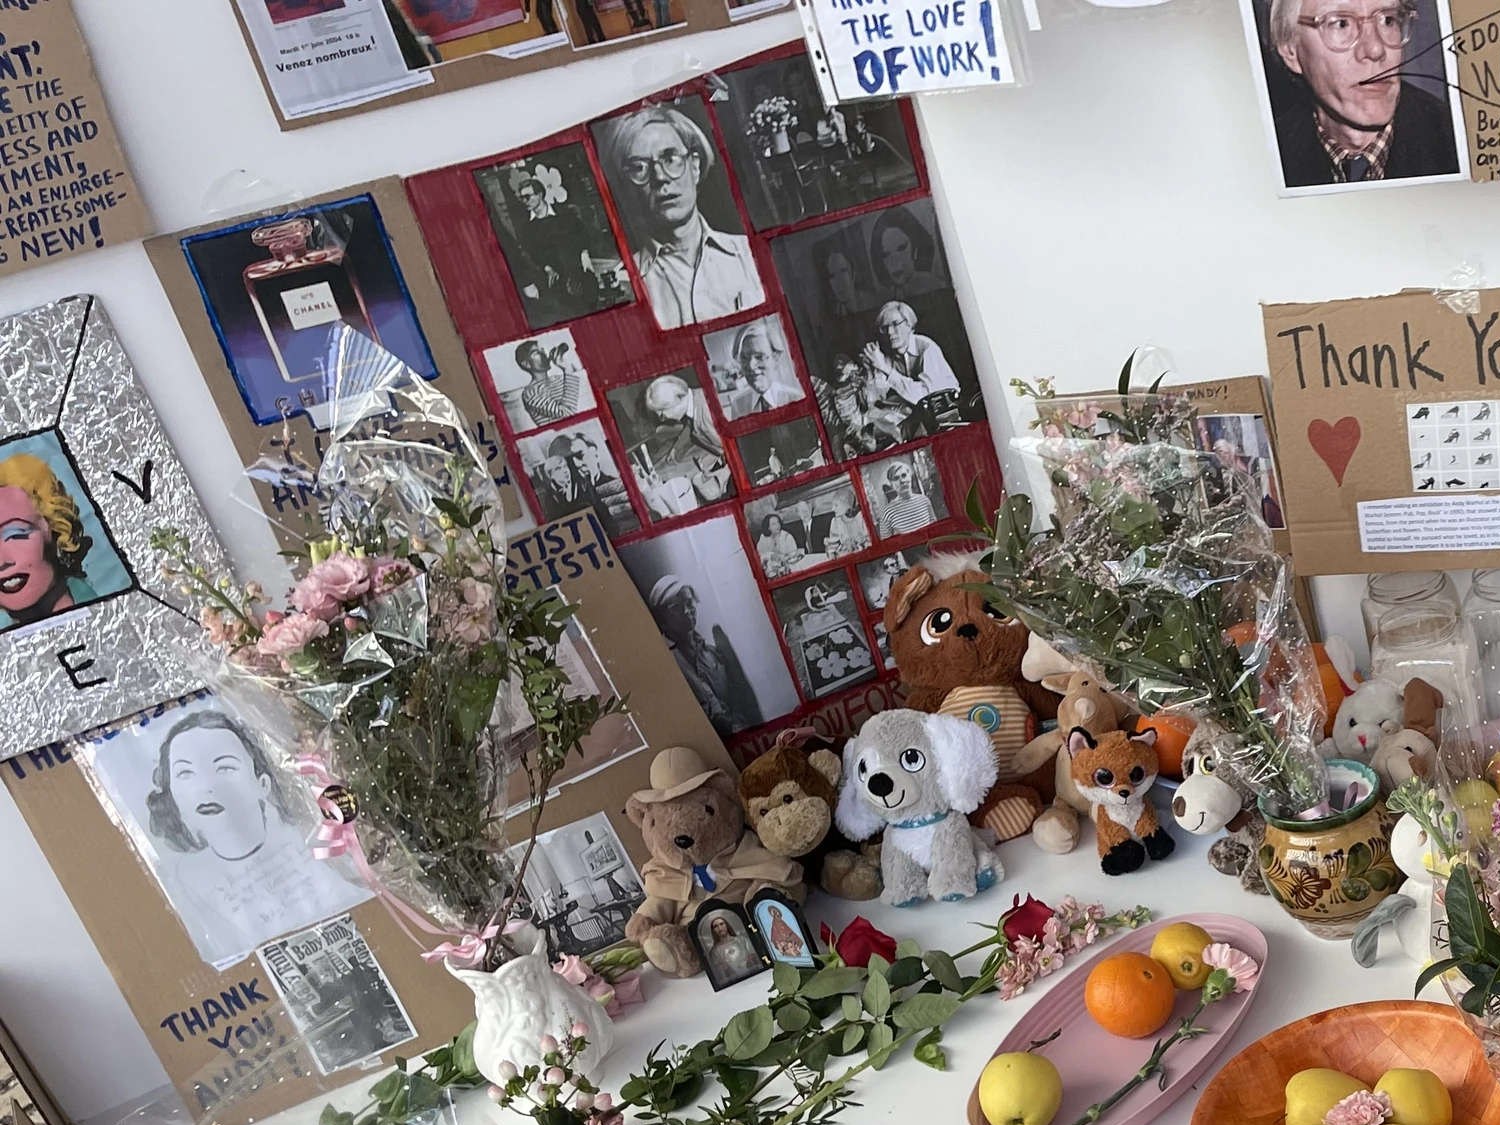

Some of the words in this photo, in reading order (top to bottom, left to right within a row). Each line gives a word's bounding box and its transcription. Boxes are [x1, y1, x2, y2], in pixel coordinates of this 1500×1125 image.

[841, 13, 893, 46] THE
[906, 0, 966, 38] LOVE
[276, 57, 313, 73] Venez
[853, 46, 908, 94] OF
[16, 77, 64, 104] THE
[55, 95, 87, 122] OF
[47, 121, 99, 151] AND
[8, 191, 34, 213] AN
[39, 169, 125, 204] ENLARGE-
[74, 191, 127, 218] SOME-
[21, 215, 105, 262] NEW!
[293, 300, 333, 316] CHANEL
[1277, 321, 1445, 391] Thank
[111, 459, 154, 505] V
[57, 643, 108, 691] E
[291, 937, 323, 962] Baby
[160, 977, 269, 1042] THANK
[208, 1010, 276, 1058] YOU
